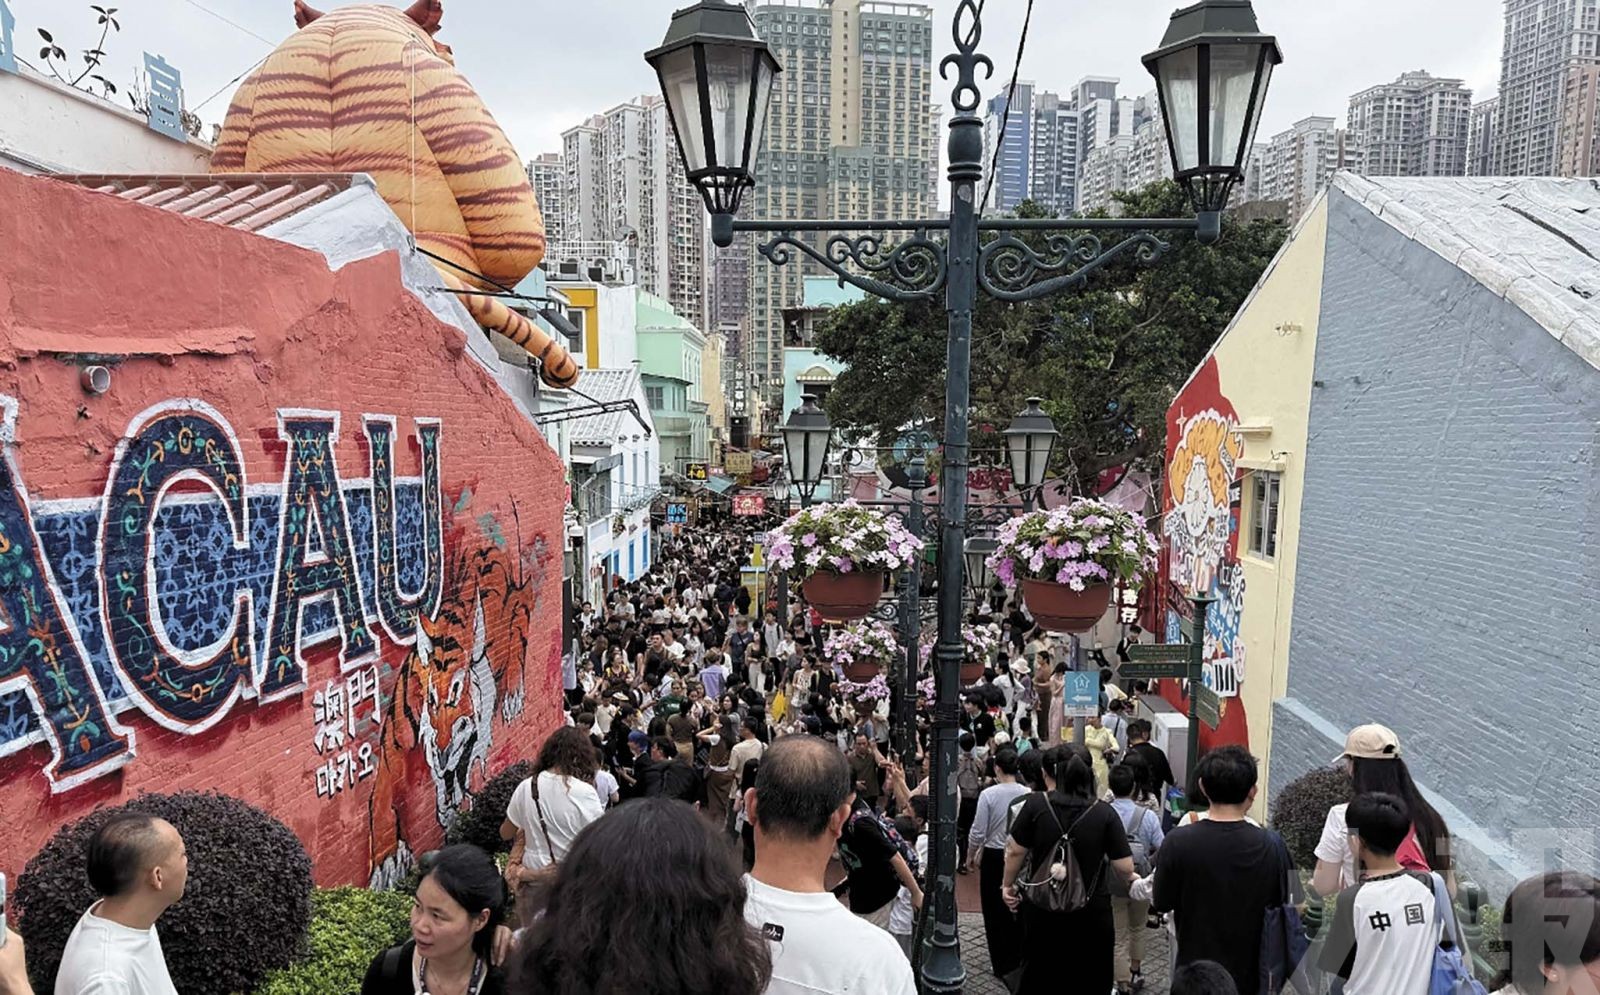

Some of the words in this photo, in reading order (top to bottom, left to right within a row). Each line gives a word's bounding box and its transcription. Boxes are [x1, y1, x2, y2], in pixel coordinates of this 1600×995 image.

[1121, 579, 1140, 625] 寄存
[312, 665, 381, 756] 澳門
[316, 742, 375, 800] 마카오
[1368, 902, 1426, 932] 中国
